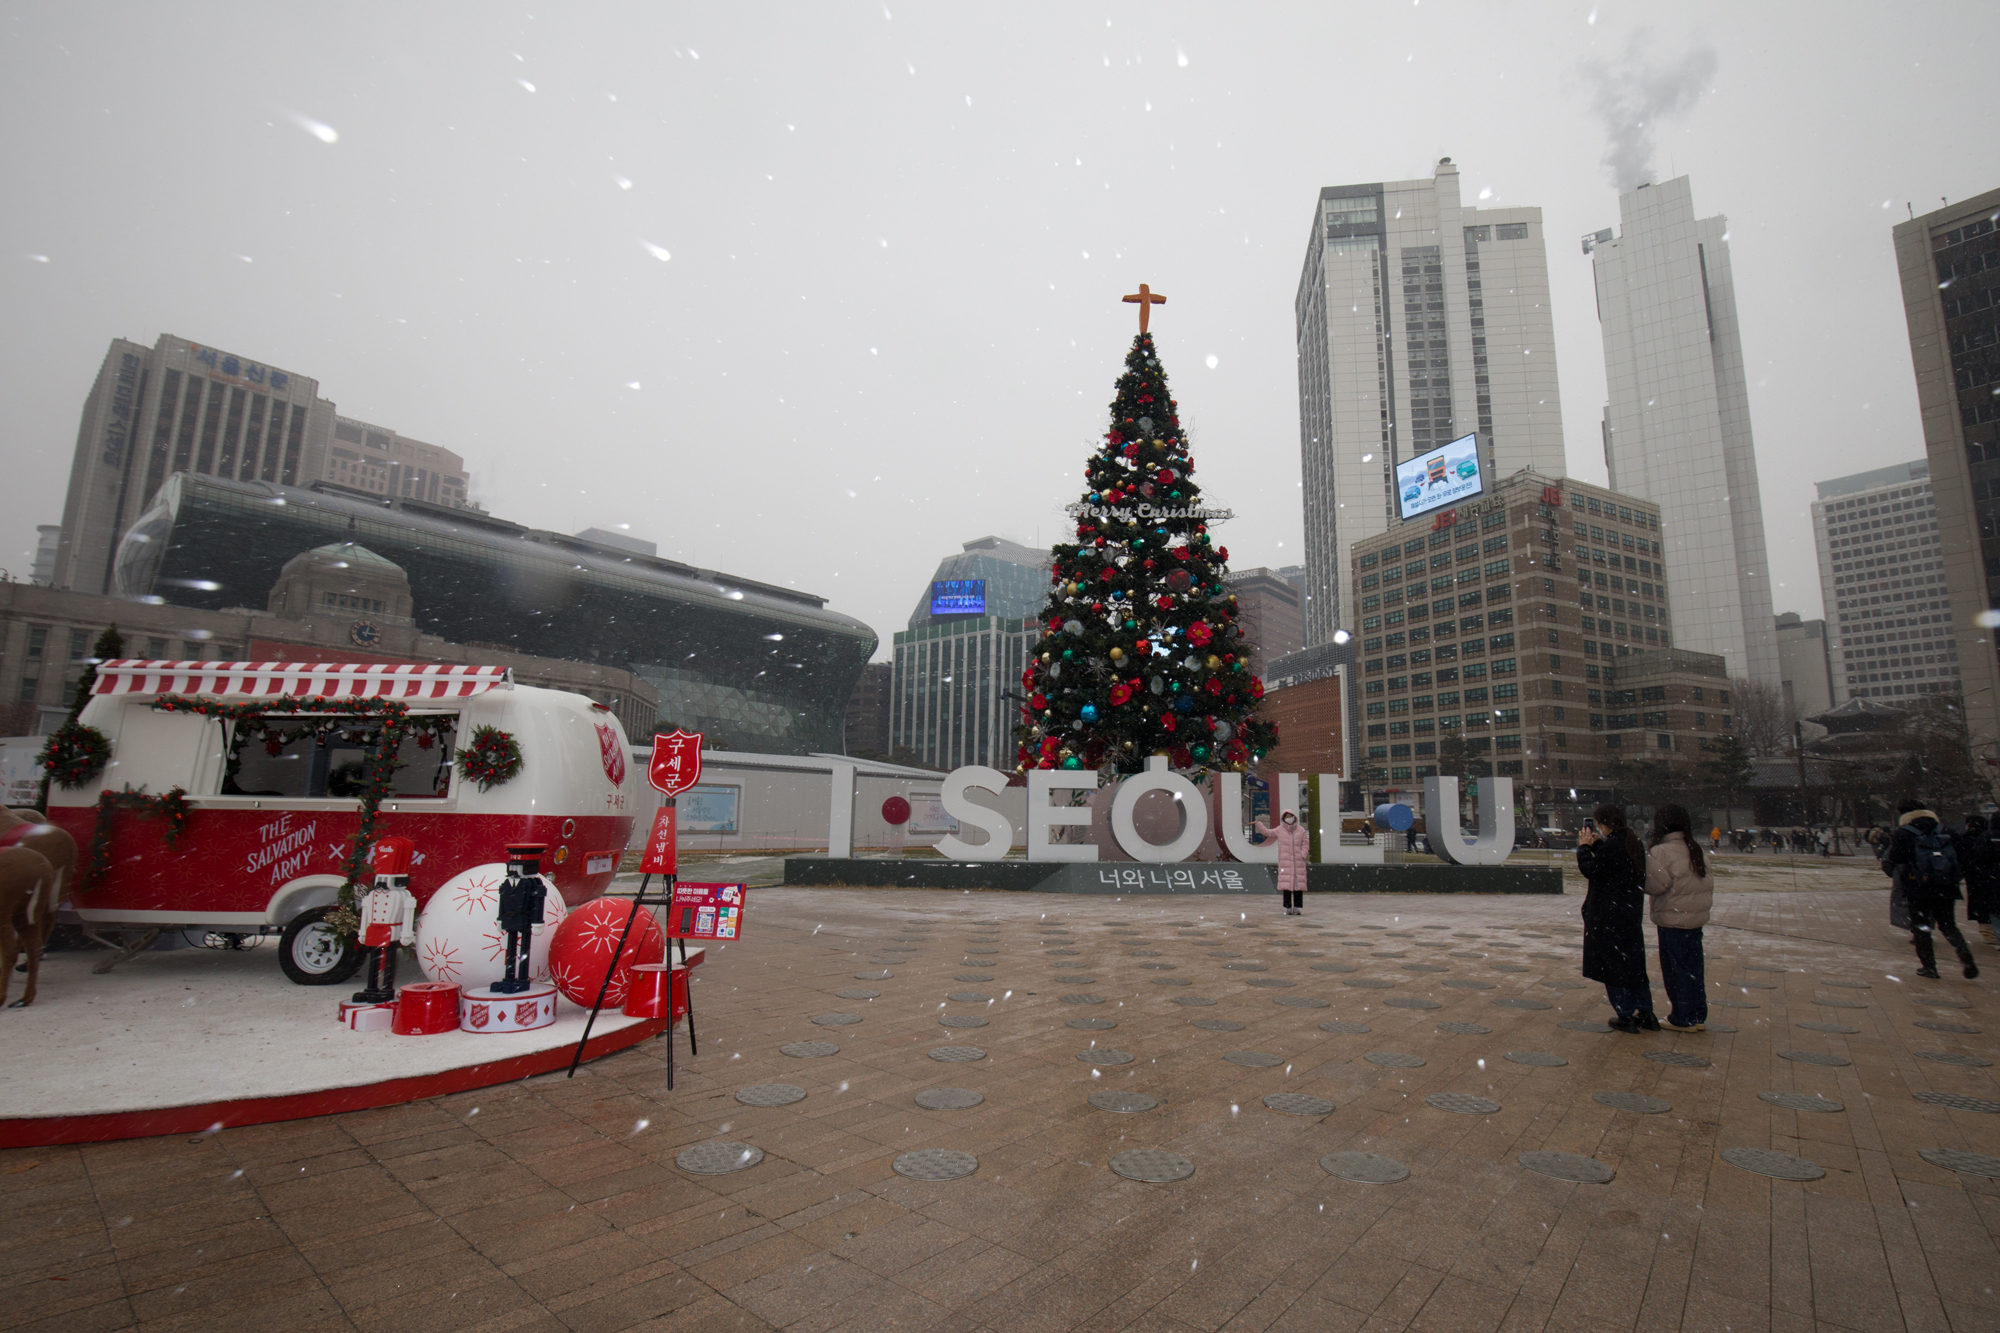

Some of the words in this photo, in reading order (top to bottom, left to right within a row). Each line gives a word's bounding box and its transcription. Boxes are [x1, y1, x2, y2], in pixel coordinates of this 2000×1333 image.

[196, 349, 288, 390] 서울신문
[334, 415, 358, 427] NANCE
[360, 423, 387, 435] CENTER
[1540, 486, 1562, 506] JEI
[1065, 502, 1130, 522] Merry
[1138, 503, 1235, 519] Christmas
[1431, 508, 1456, 530] JEI
[1458, 494, 1504, 518] 재능교육
[1293, 665, 1335, 685] PRESIDENT
[665, 738, 685, 788] 구세군
[606, 794, 624, 809] 구세군
[935, 756, 1384, 864] SEOUL
[1424, 775, 1516, 865] U
[259, 815, 291, 843] THE
[246, 820, 316, 873] SALVATION
[270, 845, 312, 885] ARMY
[1099, 869, 1146, 889] 너와
[1150, 869, 1196, 889] 나의
[1201, 869, 1244, 889] 서울
